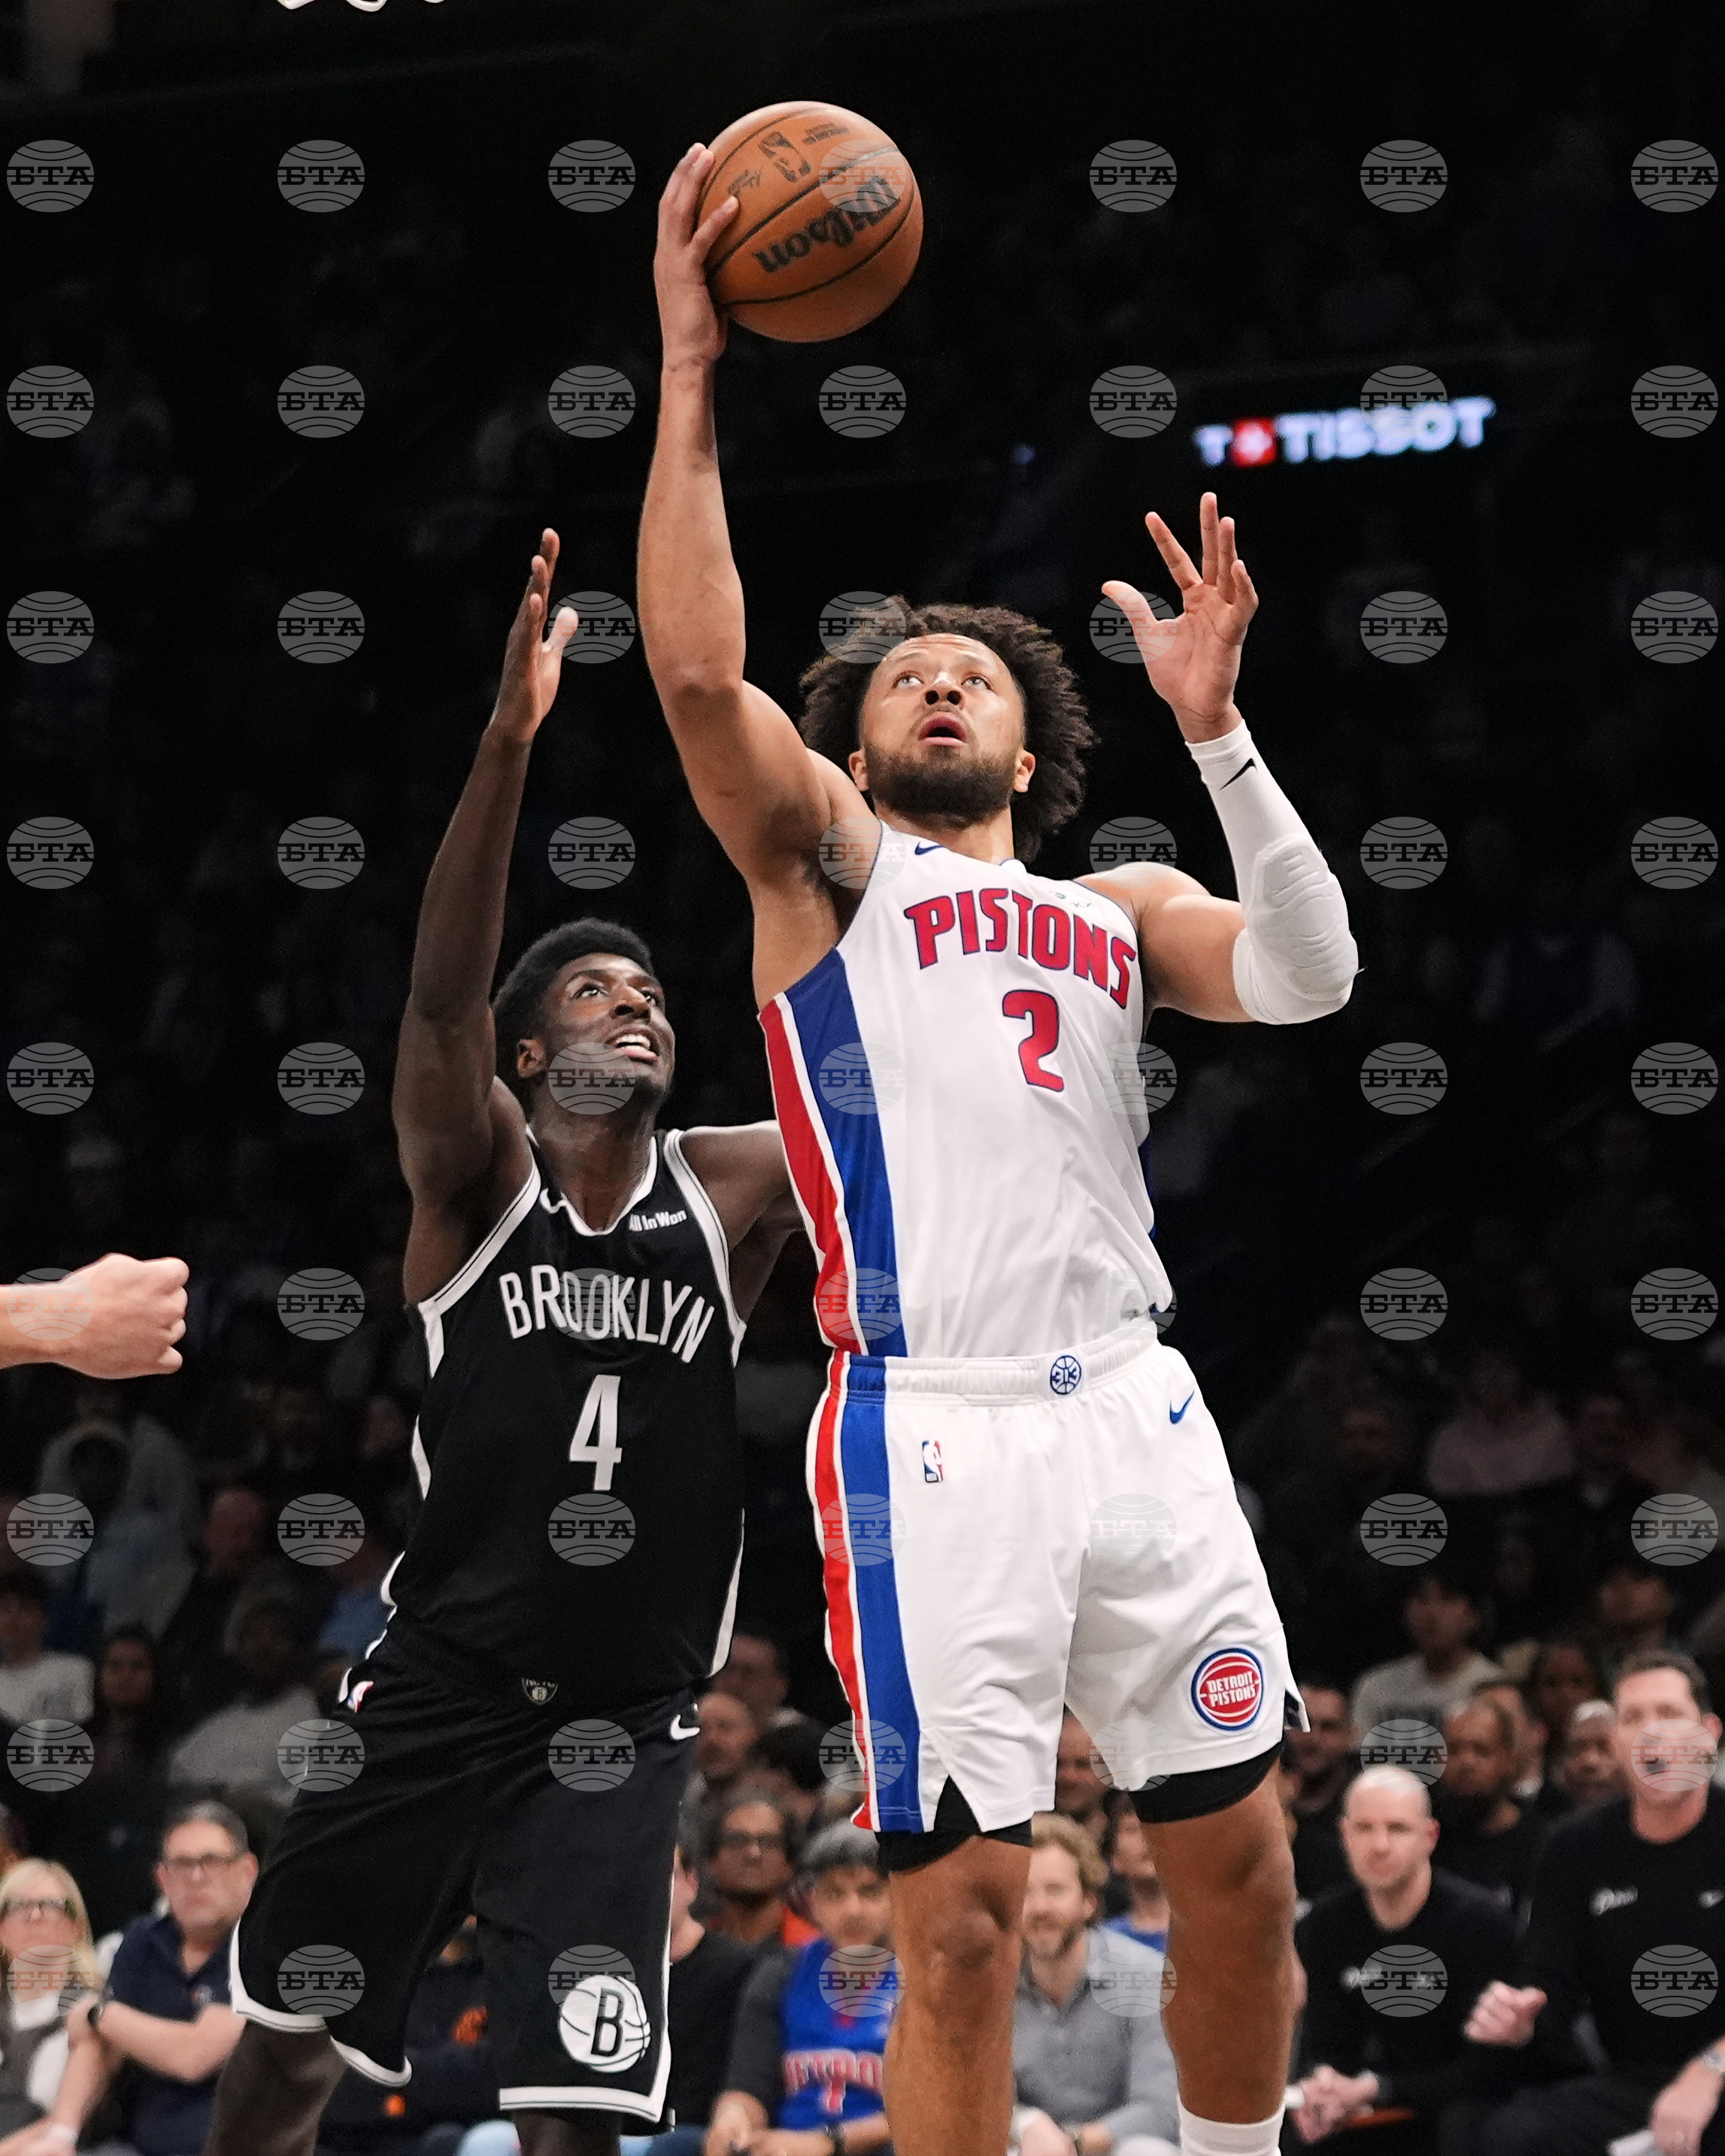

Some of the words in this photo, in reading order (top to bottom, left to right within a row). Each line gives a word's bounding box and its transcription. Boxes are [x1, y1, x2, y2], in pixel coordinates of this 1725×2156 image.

[752, 176, 901, 272] Wilson
[1274, 395, 1496, 463] TISSOT
[904, 887, 1137, 1010] PISTONS
[1002, 989, 1065, 1093] 2
[499, 1264, 715, 1363] BROOKLYN
[569, 1374, 623, 1491] 4
[1205, 1670, 1254, 1693] DETROIT
[1208, 1684, 1257, 1707] PISTONS
[590, 1987, 624, 2057] B
